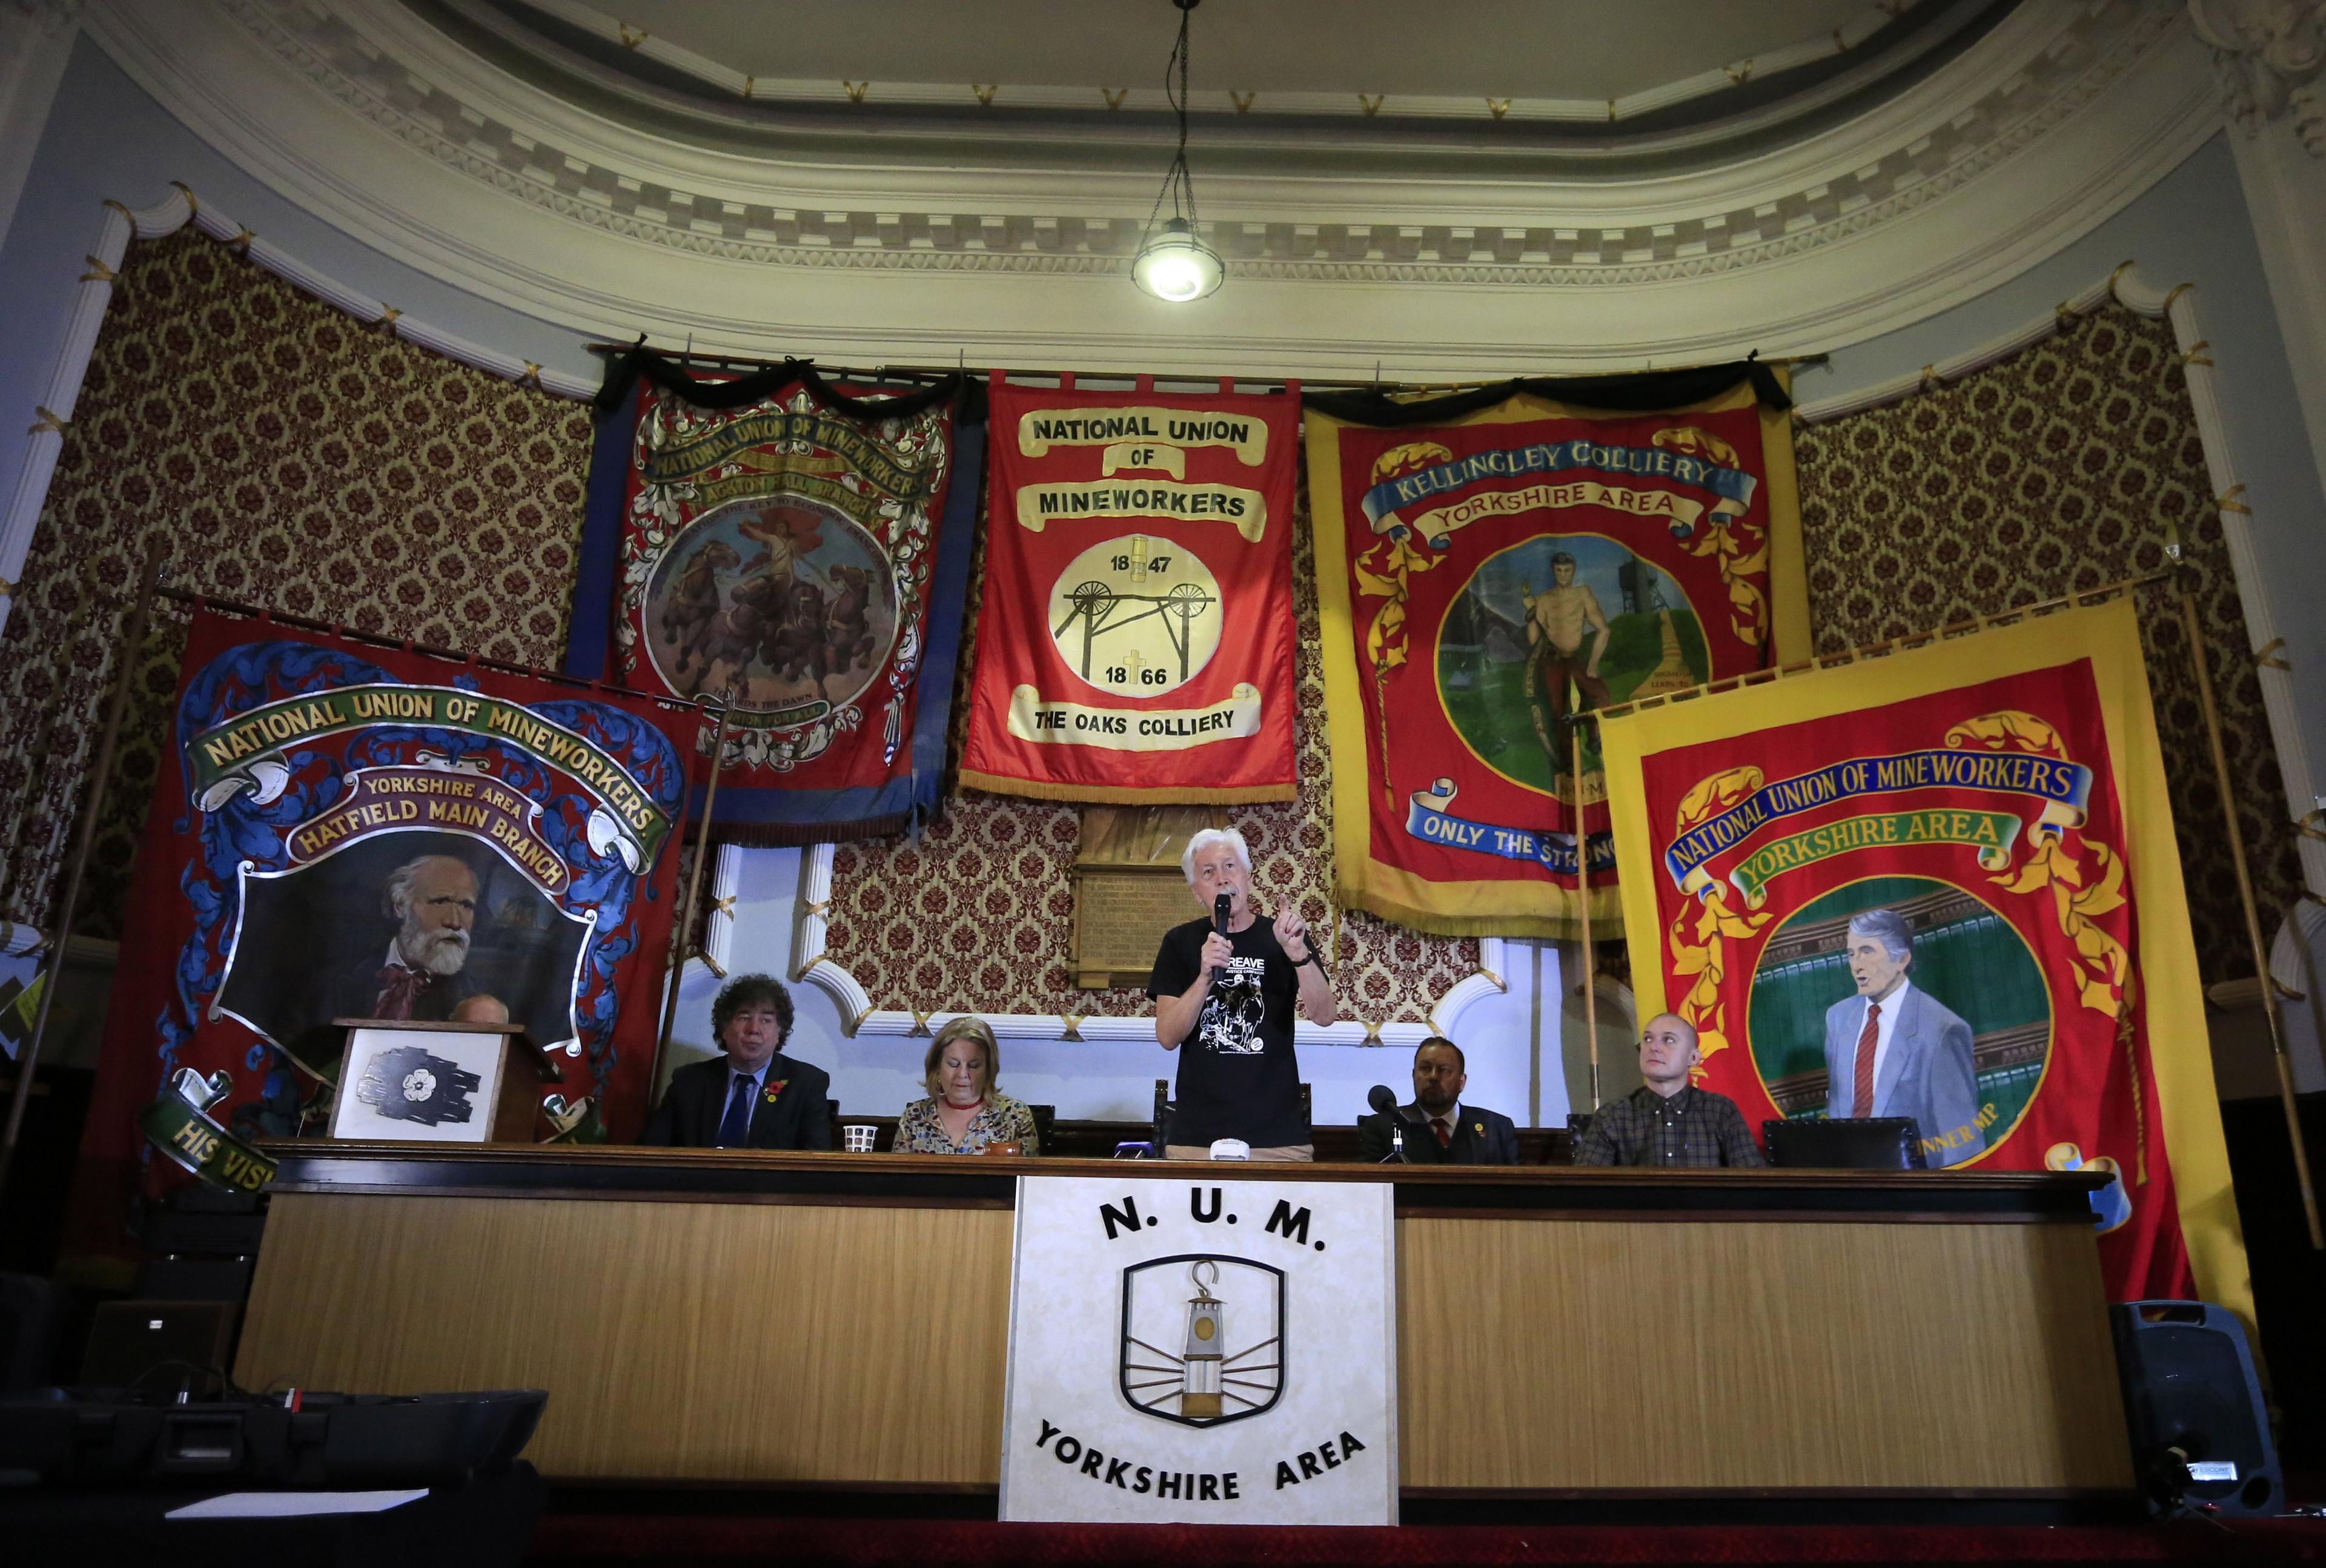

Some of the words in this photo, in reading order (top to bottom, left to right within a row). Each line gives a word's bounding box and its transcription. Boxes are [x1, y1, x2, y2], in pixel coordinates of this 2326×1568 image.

[655, 437, 737, 475] NATIONAL
[734, 419, 786, 442] UNION
[792, 417, 811, 436] OF
[1033, 417, 1159, 440] NATIONAL
[1168, 420, 1248, 442] UNION
[1131, 449, 1154, 465] OF
[1396, 446, 1562, 502] KELLINGLEY
[1571, 442, 1714, 483] COLLIERY
[706, 477, 767, 502] ACKTON
[774, 475, 807, 491] HALL
[814, 483, 870, 515] BRANCH
[725, 503, 744, 514] THE
[749, 498, 772, 510] KEY
[1039, 489, 1245, 517] MINEWORKERS
[1433, 485, 1586, 528] YORKSHIRE
[1599, 489, 1674, 514] AREA
[1110, 555, 1129, 571] 18
[1148, 557, 1171, 573] 47
[1105, 667, 1127, 684] 18
[1141, 669, 1167, 685] 66
[714, 687, 757, 707] TORDS
[761, 701, 779, 709] THE
[783, 693, 812, 706] DAWN
[1035, 711, 1067, 729] THE
[1075, 713, 1127, 734] OAKS
[1139, 710, 1234, 736] COLLIERY
[204, 701, 346, 767] NATIONAL
[352, 693, 432, 718] UNION
[446, 698, 479, 723] OF
[489, 706, 654, 838] MINEWORKERS.
[364, 776, 475, 799] YORKSHIRE
[479, 787, 522, 820] AREA
[1671, 798, 1768, 872] NATIONAL
[1767, 770, 1837, 813] UNION
[1841, 762, 1869, 793] OF
[1878, 755, 2073, 796] MINEWORKERS
[297, 800, 418, 855] HATFIELD
[428, 800, 489, 829] MAIN
[490, 816, 564, 886] BRANCH
[1423, 816, 1485, 845] ONLY
[1494, 830, 1533, 854] THE
[1740, 818, 1898, 884] YORKSHIRE
[1908, 813, 1999, 843] AREA
[1228, 956, 1265, 969] REAVE
[1972, 1102, 1999, 1133] MP
[173, 1119, 219, 1162] HIS
[1099, 1196, 1158, 1240] N.
[1190, 1187, 1237, 1225] U.
[1265, 1199, 1325, 1251] M.
[1035, 1419, 1241, 1501] YORKSHIRE
[1276, 1431, 1366, 1490] AREA
